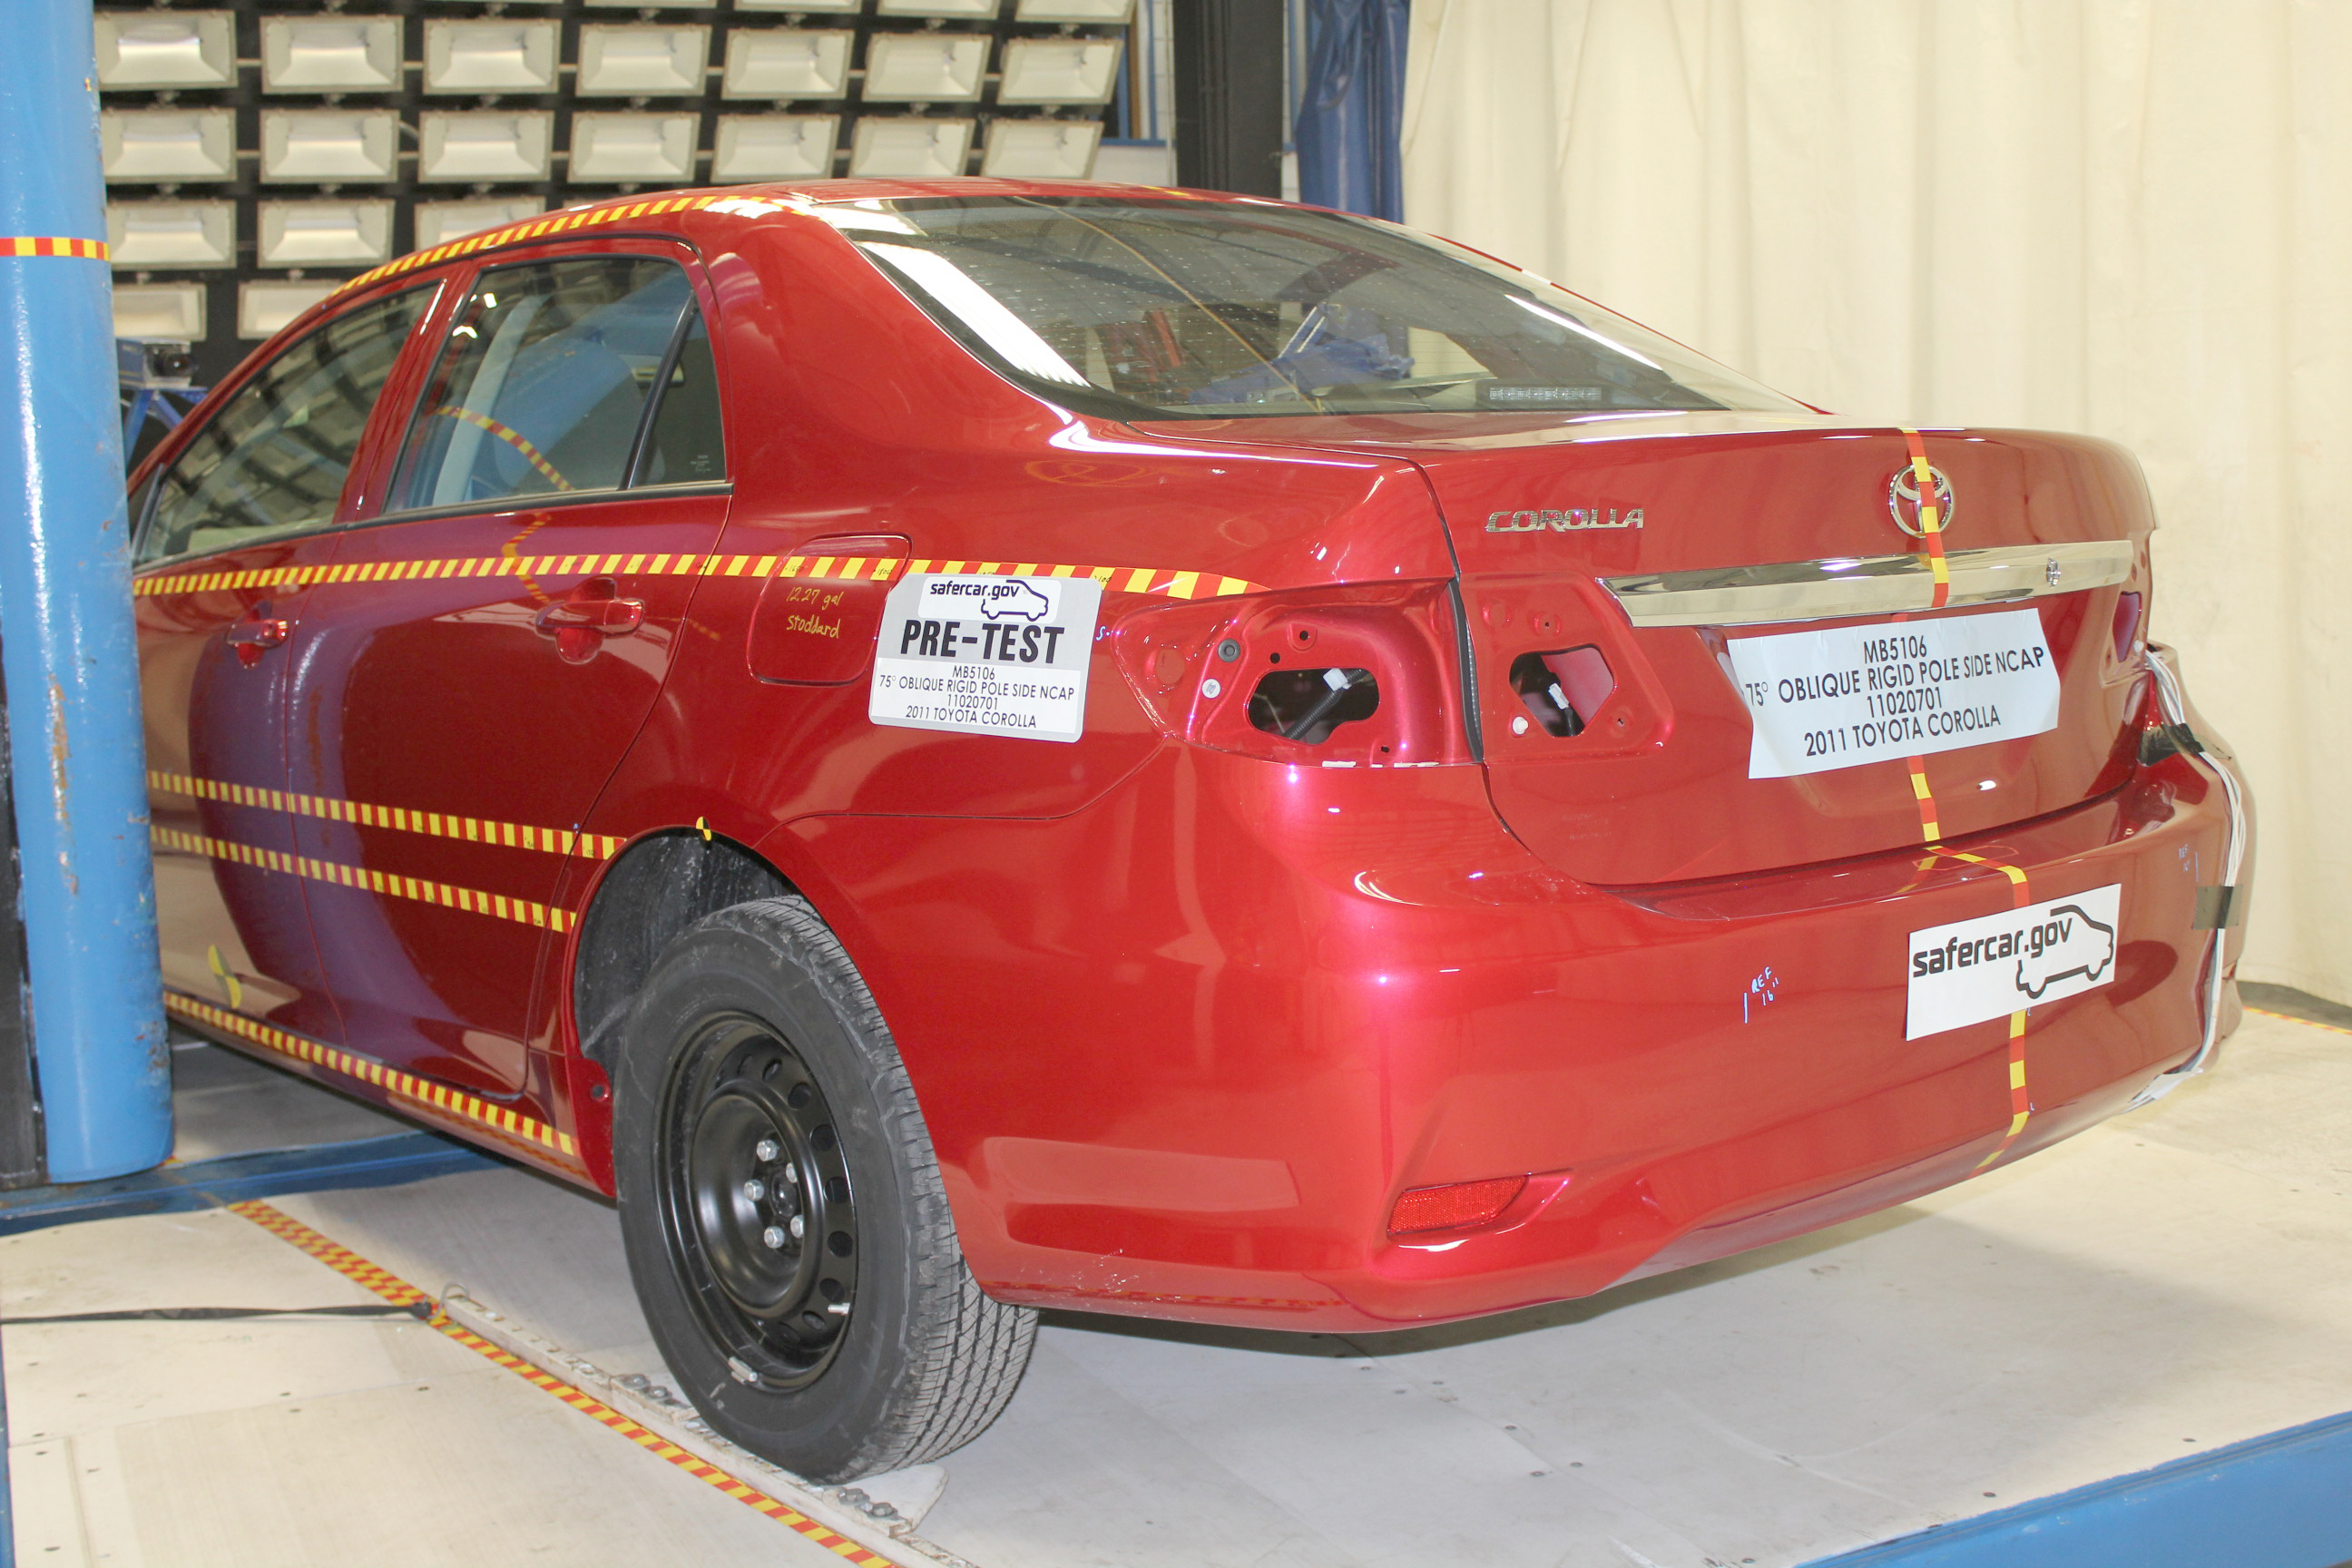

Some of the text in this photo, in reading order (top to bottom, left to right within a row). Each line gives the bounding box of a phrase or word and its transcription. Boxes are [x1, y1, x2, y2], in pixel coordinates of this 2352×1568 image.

[1485, 507, 1645, 533] COROLLA
[786, 586, 845, 611] 12.27 gal
[929, 580, 1021, 601] safercar.gov
[900, 619, 1065, 664] PRE-TEST
[1863, 634, 1927, 665] MB5106
[952, 665, 996, 681] MB5106
[1779, 670, 1861, 703] OBLIQUE
[1867, 663, 1916, 691] RIGID
[1918, 657, 1960, 684] POLE
[1963, 654, 1993, 679] SIDE
[1994, 645, 2044, 673] NCAP
[899, 676, 944, 691] OBLIQUE
[947, 679, 977, 693] RIGID
[981, 681, 1008, 696] POLE
[1012, 683, 1037, 698] SIDE
[1039, 686, 1075, 701] NCAP
[947, 694, 999, 710] 11020701
[1867, 686, 1943, 719] 11020701
[905, 705, 1037, 729] 2011 TOYOTA COROLLA
[1803, 704, 2002, 757] 2011 TOYOTA COROLLA
[1912, 917, 2073, 978] safercar.gov
